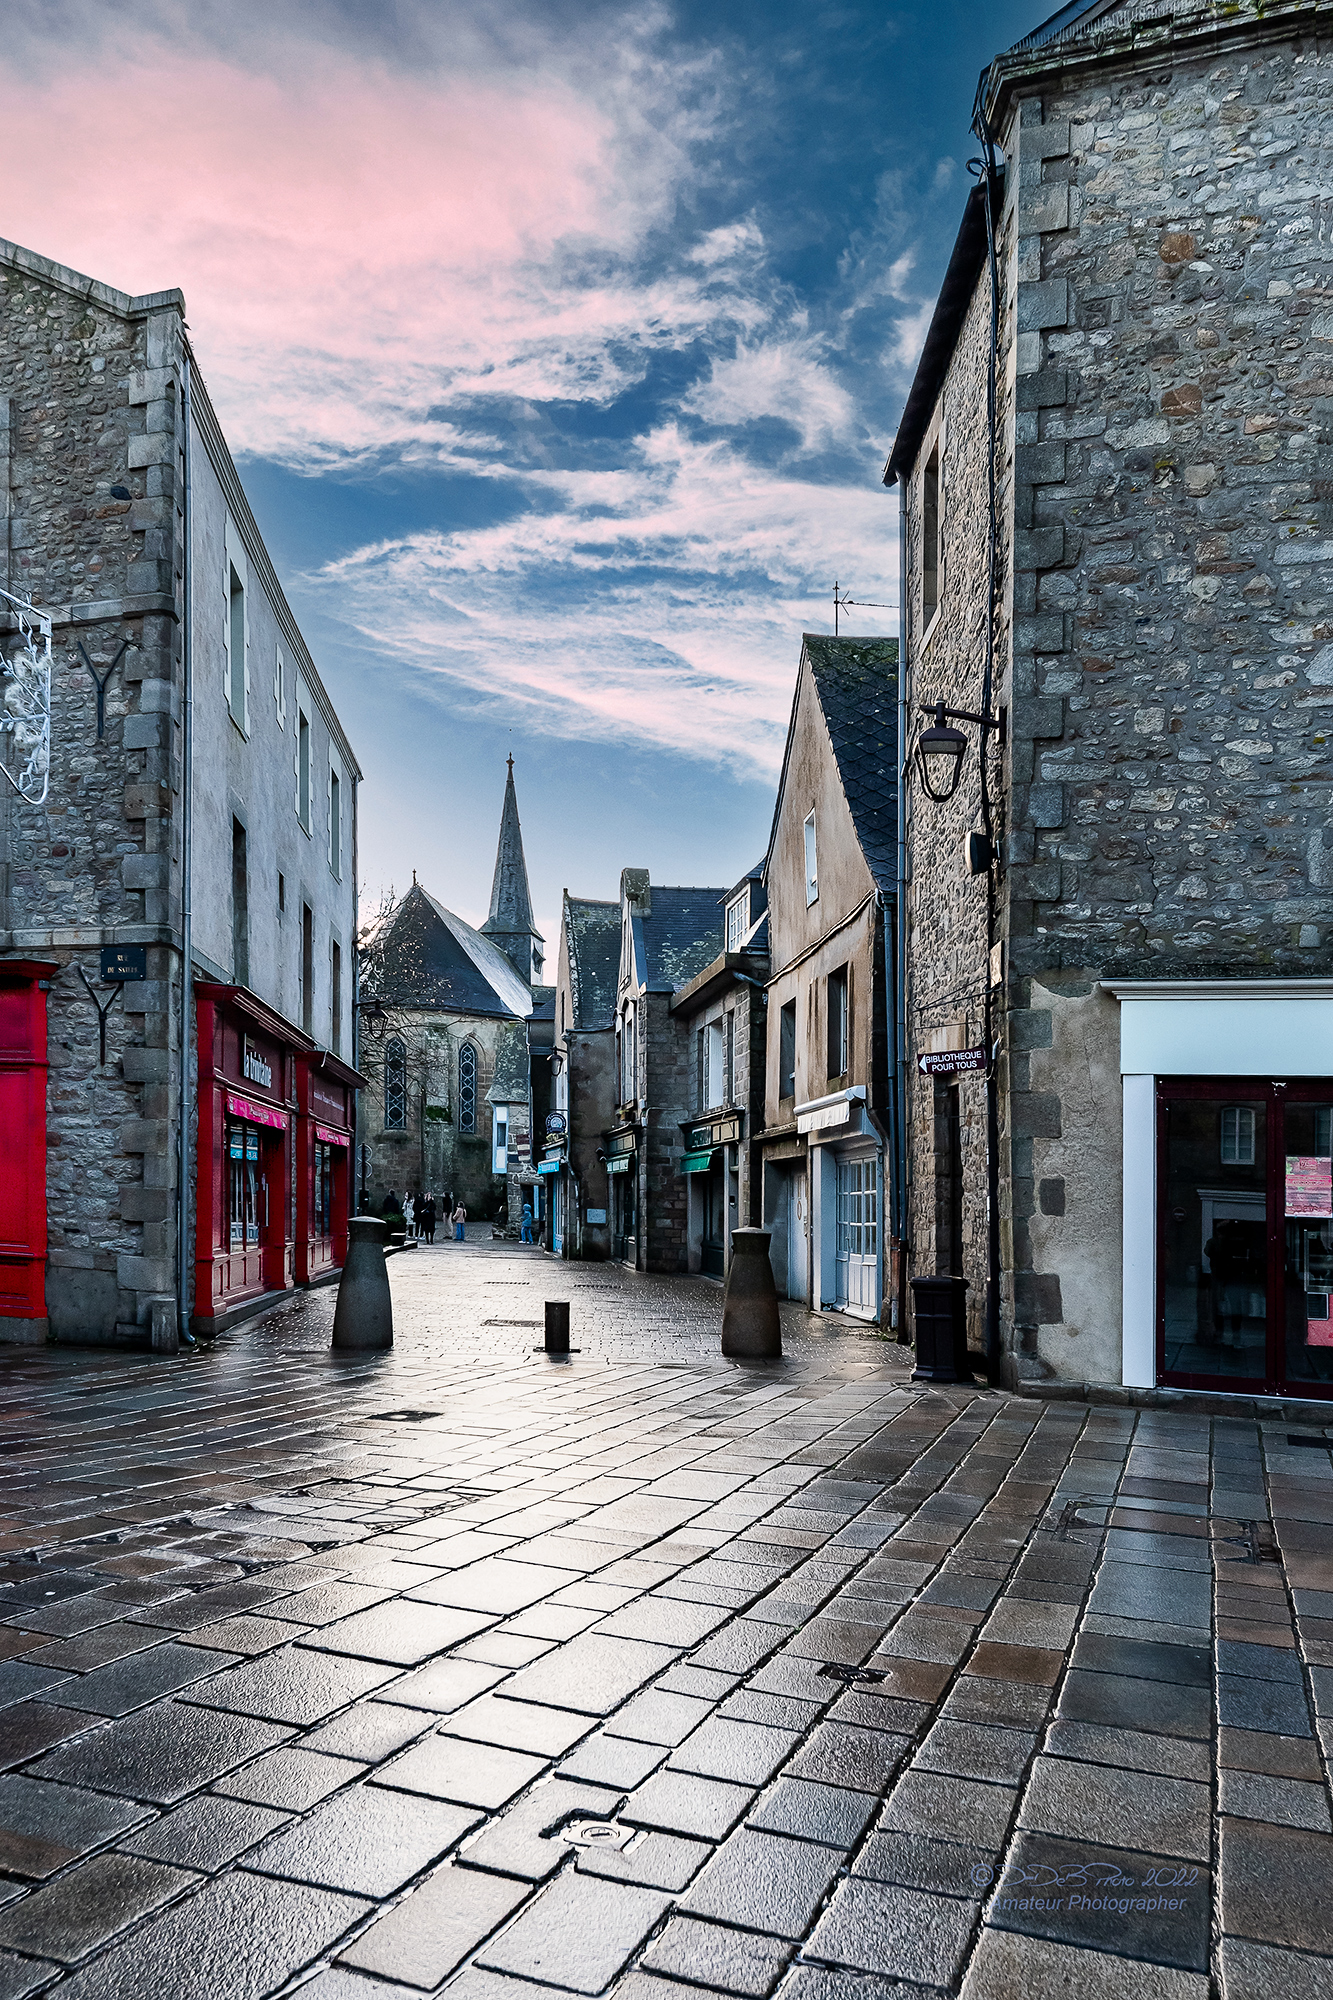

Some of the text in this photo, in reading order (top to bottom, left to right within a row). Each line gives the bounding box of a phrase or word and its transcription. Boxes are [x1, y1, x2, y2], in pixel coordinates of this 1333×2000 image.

[925, 1050, 982, 1064] BIBLIOTHEQUE
[931, 1060, 977, 1072] POUR TOUS
